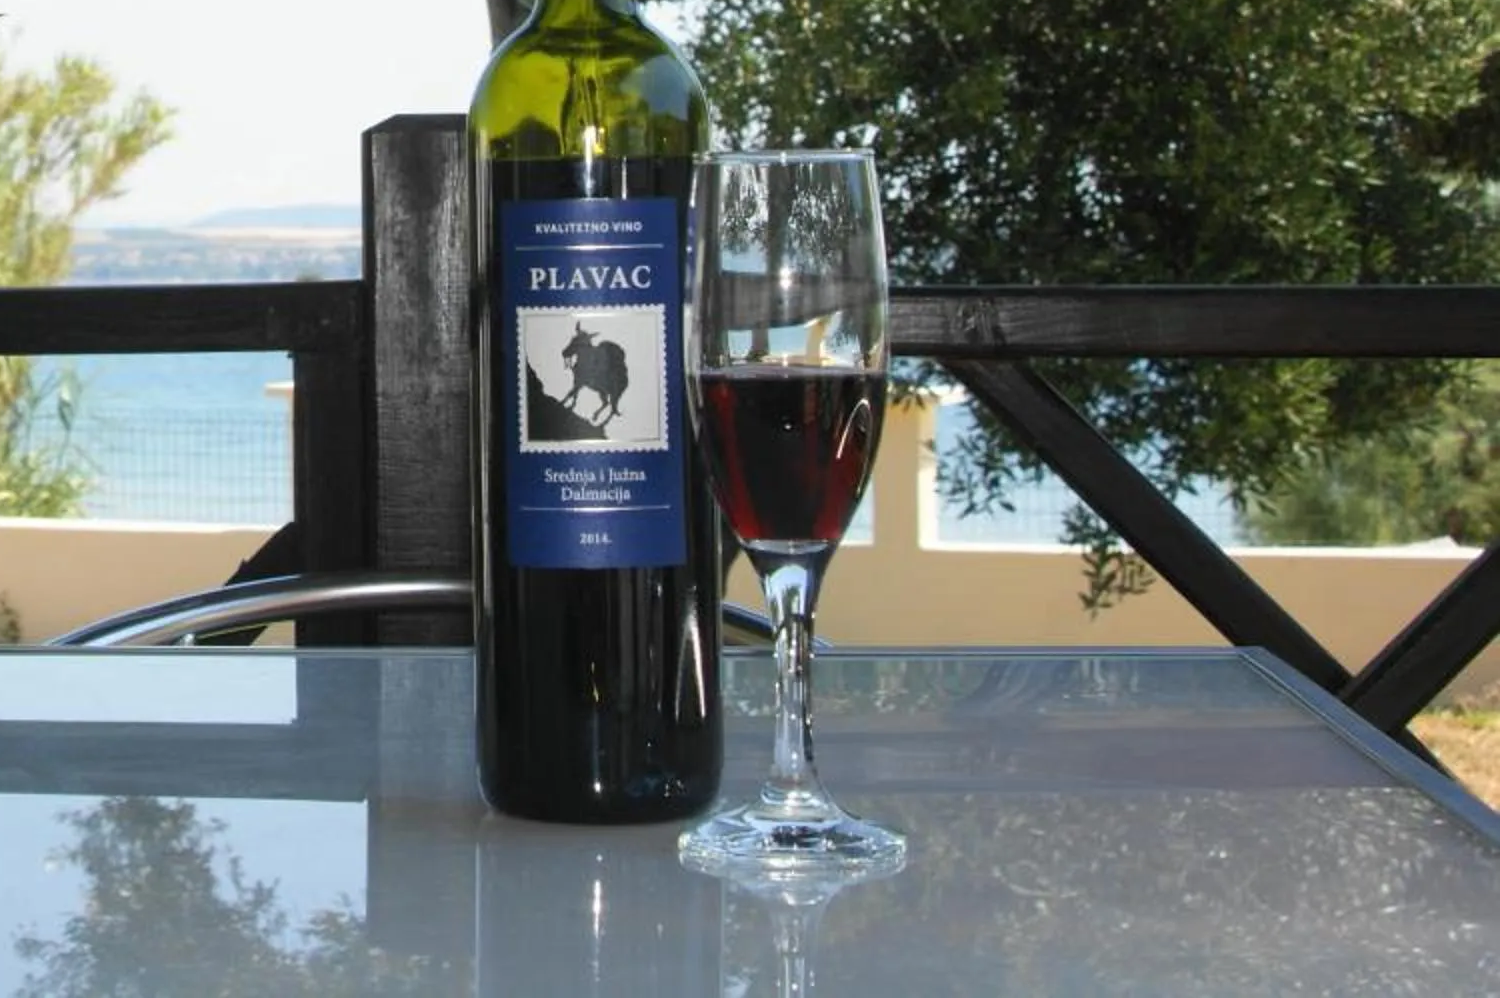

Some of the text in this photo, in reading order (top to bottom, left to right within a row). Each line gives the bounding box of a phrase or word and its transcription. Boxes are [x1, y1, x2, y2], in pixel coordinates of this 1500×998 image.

[534, 221, 643, 235] KVALITETNO VINO
[528, 265, 652, 291] PLAVAC
[544, 468, 596, 486] Srednja
[561, 487, 632, 504] Dalmacija
